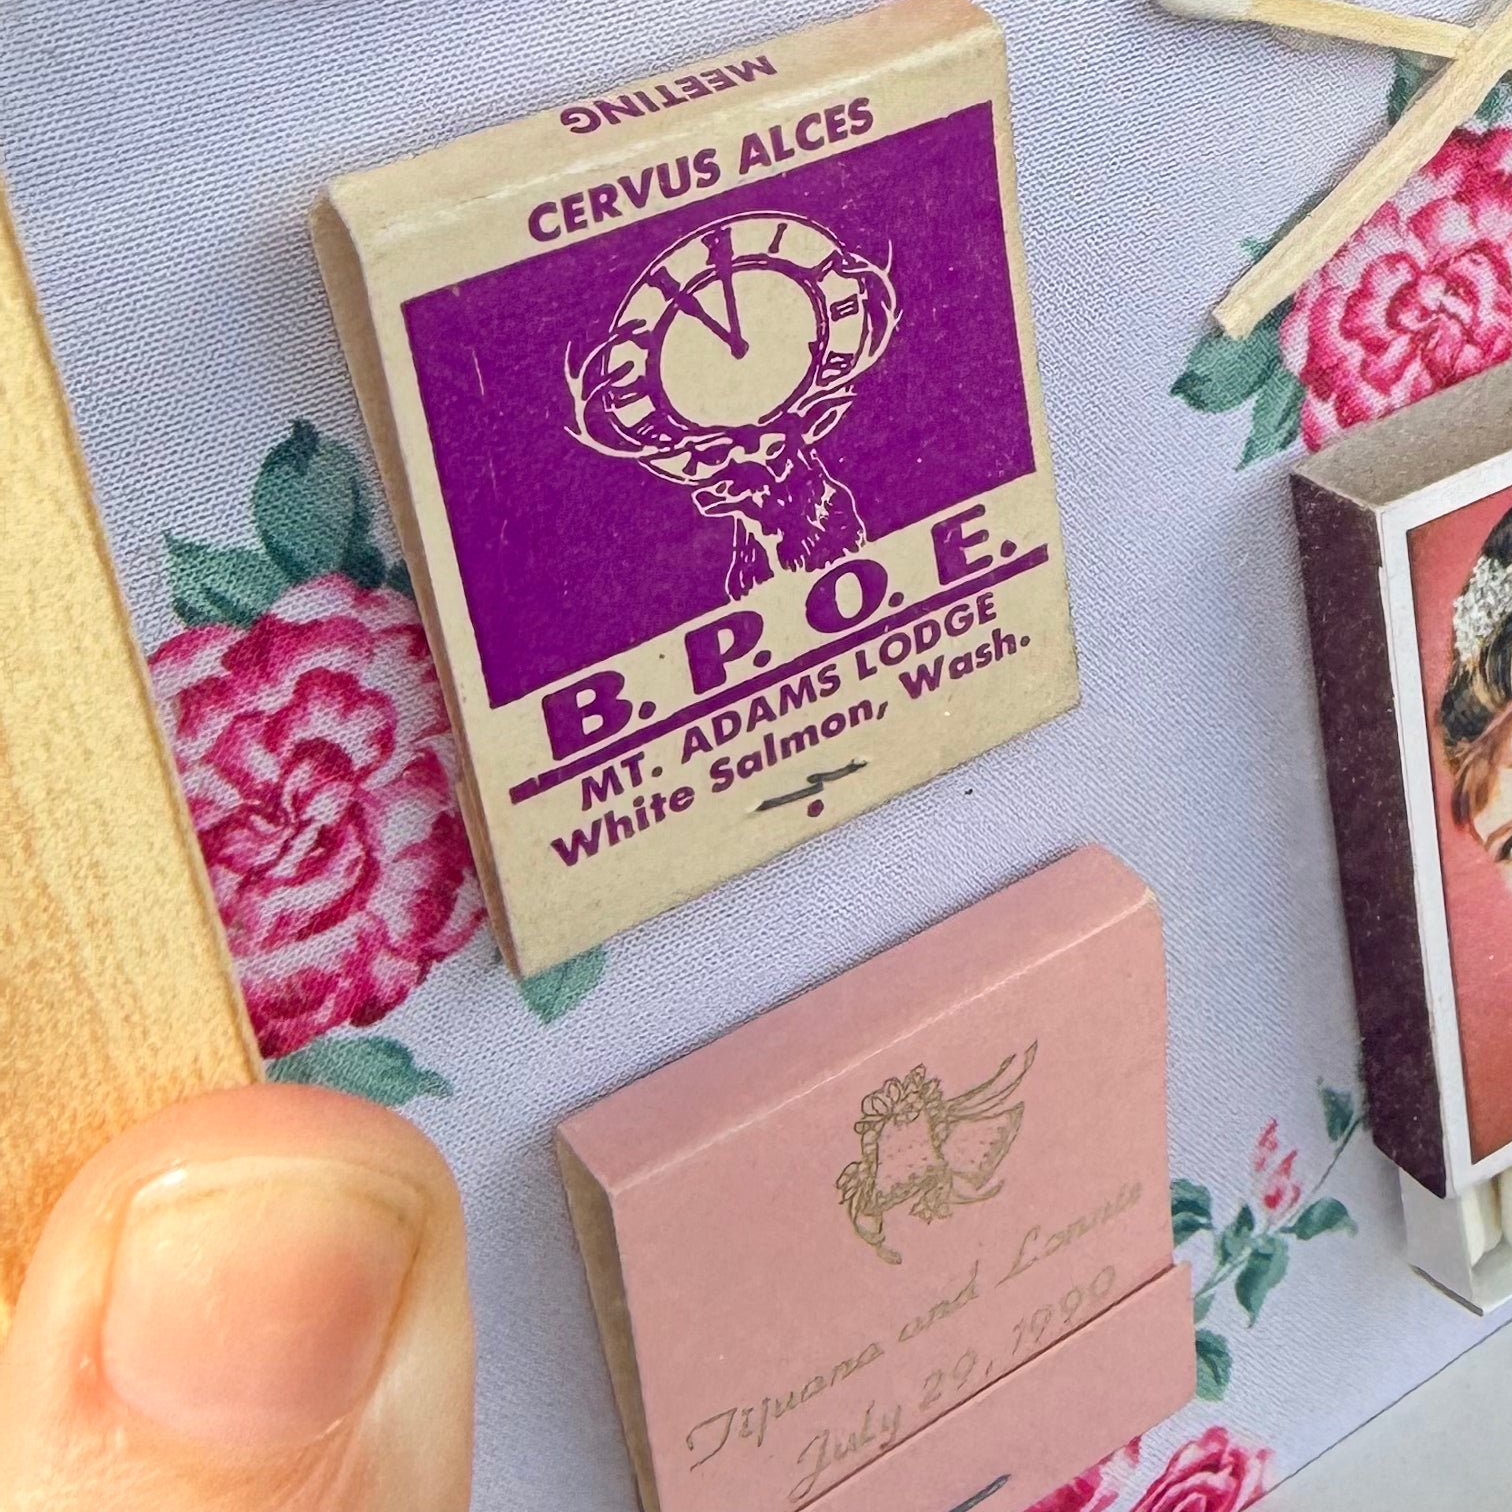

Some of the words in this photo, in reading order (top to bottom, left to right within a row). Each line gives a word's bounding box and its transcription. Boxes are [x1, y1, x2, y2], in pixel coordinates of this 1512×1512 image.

[559, 54, 778, 135] MEETING
[526, 148, 721, 244] CERVUS
[737, 96, 876, 176] ALCES
[541, 669, 657, 762] B.
[683, 610, 771, 696] P.
[805, 558, 905, 634] O.
[931, 503, 1018, 586] E.
[580, 752, 664, 813] MT.
[680, 663, 842, 766] ADAMS
[854, 591, 998, 682] LODGE
[550, 785, 697, 867] White
[709, 700, 889, 792] Salmon,
[898, 630, 1033, 701] Wash.
[898, 1258, 980, 1342] and
[788, 1399, 902, 1504] July
